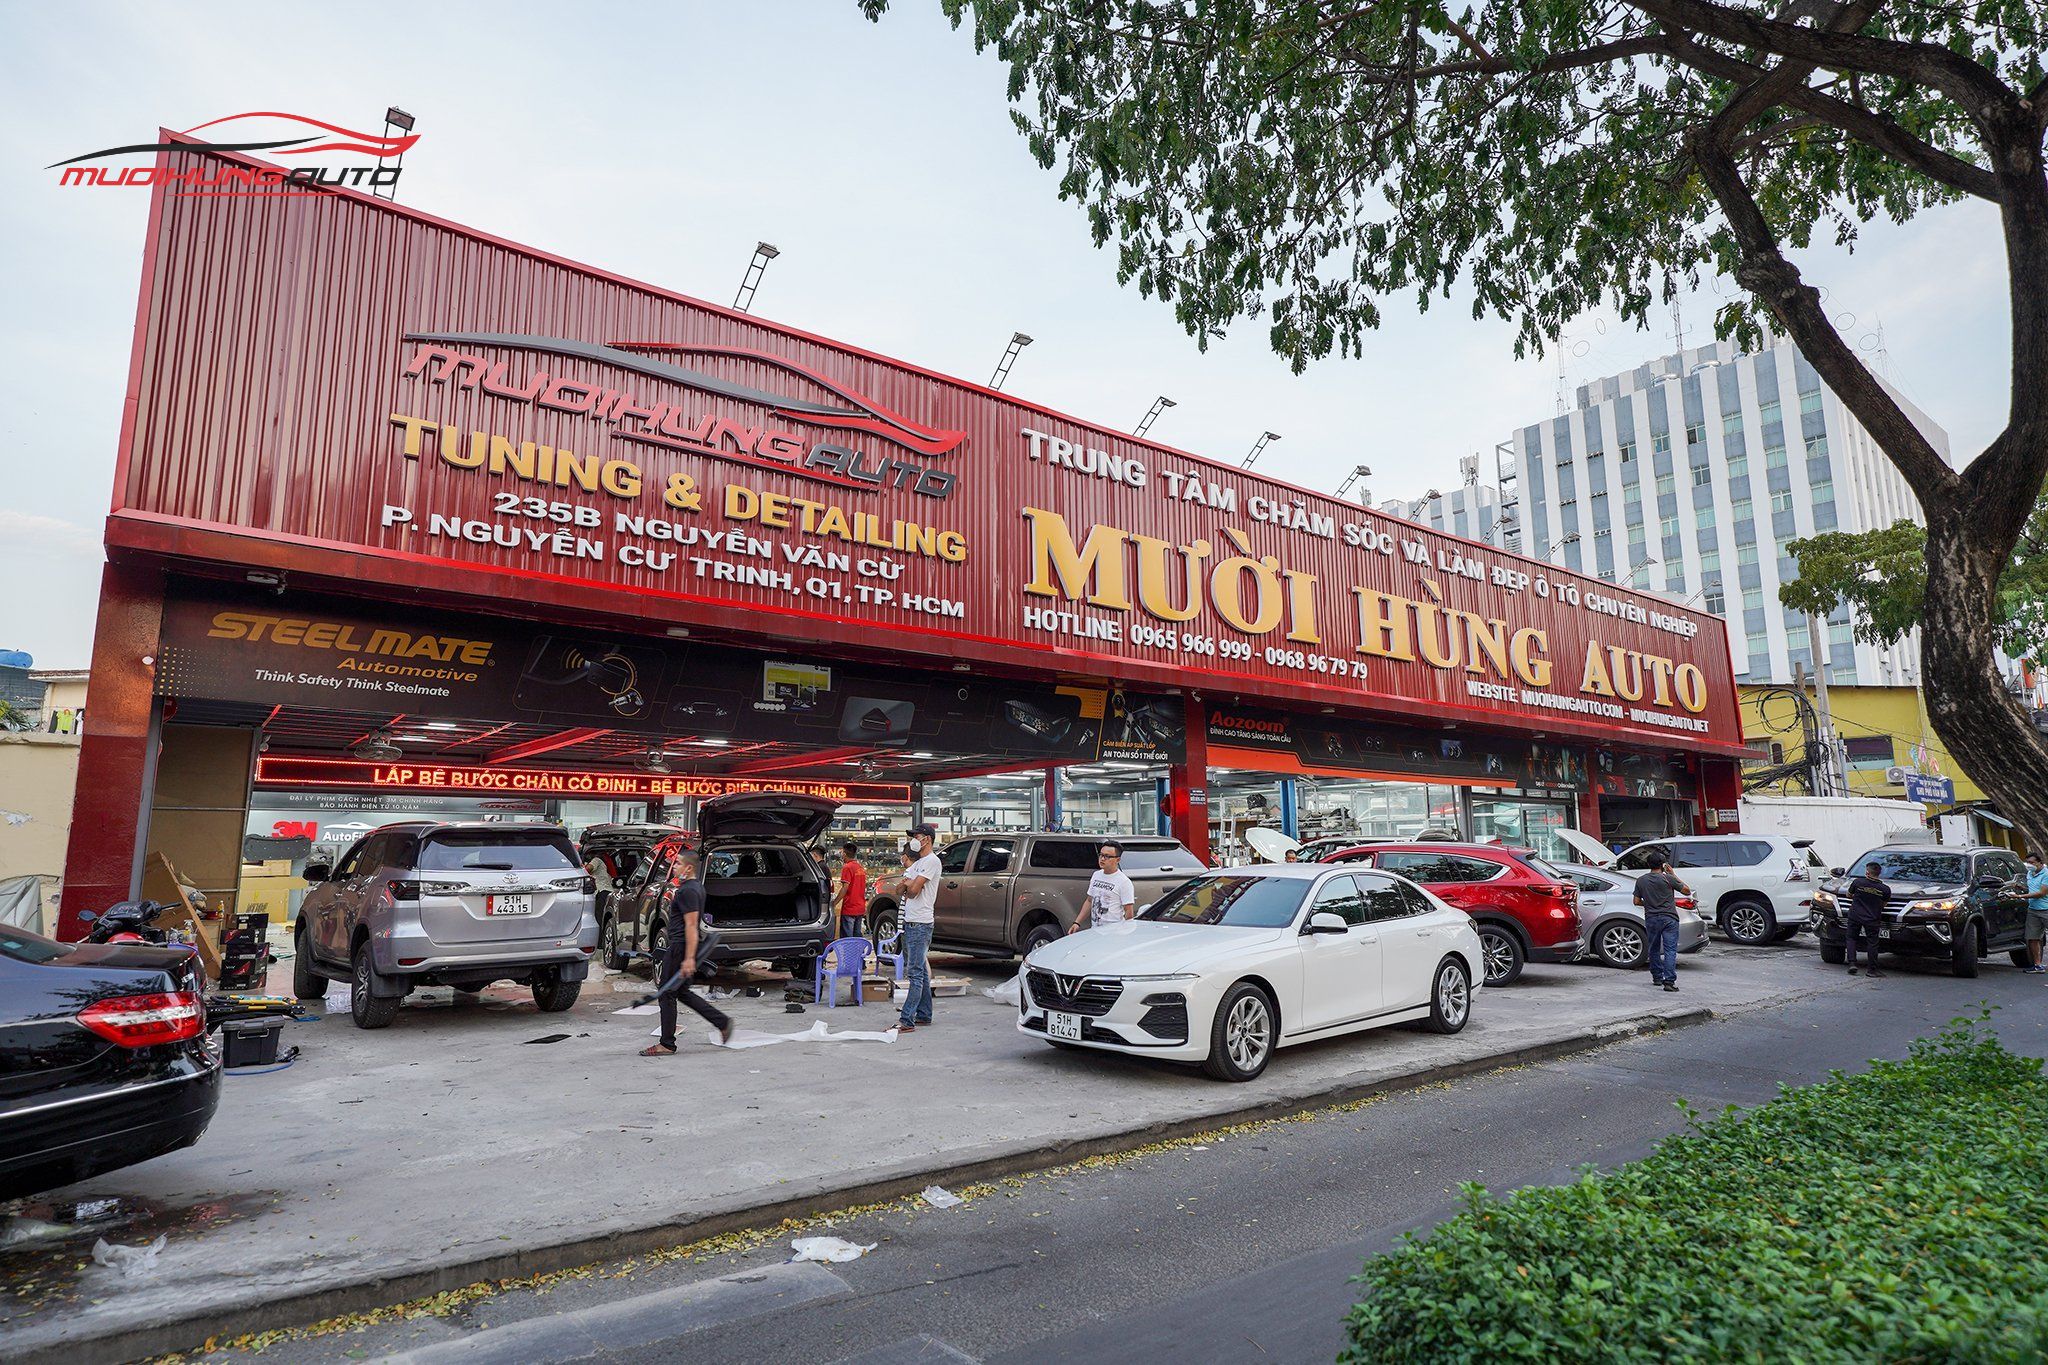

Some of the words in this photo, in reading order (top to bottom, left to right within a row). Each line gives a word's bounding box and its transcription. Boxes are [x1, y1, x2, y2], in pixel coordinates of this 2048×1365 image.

[390, 413, 642, 498] TUNING
[663, 472, 702, 512] &
[725, 484, 967, 562] DETAILING
[493, 492, 601, 527] 235B
[616, 512, 771, 559] NGUYỄN
[782, 543, 850, 573] VĂN
[857, 556, 905, 580] CỪ
[1022, 428, 1146, 488] TRUNG
[1162, 470, 1235, 513] TÂM
[1248, 496, 1334, 540] CHĂM
[1343, 519, 1394, 556] SÓC
[1400, 536, 1432, 568] VÀ
[1437, 548, 1485, 582] LÀM
[1490, 566, 1530, 596] ĐẸP
[1535, 573, 1550, 599] Ô
[1554, 582, 1580, 606] TÔ
[1584, 592, 1647, 626] CHUYÊN
[1650, 606, 1698, 641] NGHIỆP
[382, 504, 418, 531] P.
[429, 513, 604, 560] NGUYỄN
[619, 546, 676, 571] CƯ
[690, 557, 800, 596] TRINH,
[902, 592, 965, 618] HCM
[1022, 505, 1321, 645] MƯỜI
[1352, 577, 1551, 687] HÙNG
[1580, 640, 1708, 713] AUTO
[1023, 606, 1123, 643] HOTLINE:
[1130, 624, 1178, 651] 0965
[1181, 632, 1215, 656] 966
[1219, 639, 1251, 661] 999
[1265, 646, 1305, 670] 0968
[336, 656, 479, 683] Automotive
[255, 669, 294, 683] Think
[297, 673, 343, 690] Safety
[346, 677, 382, 692] Think
[384, 681, 450, 698] Steelmate
[1466, 680, 1518, 703] WEBSITE:
[1522, 689, 1624, 719] MUOIHUNGAUTO.COM
[1209, 711, 1285, 733] Aozoom
[1103, 750, 1114, 758] AN
[1114, 749, 1130, 758] TOÀN
[1130, 749, 1139, 759] SỐ
[513, 773, 563, 790] CHÂN
[568, 775, 593, 790] CỐ
[271, 821, 317, 842] 3M
[497, 904, 528, 914] 443.15
[504, 895, 521, 904] 51H
[1051, 1024, 1078, 1038] 814.47
[1057, 1013, 1072, 1026] 51H
